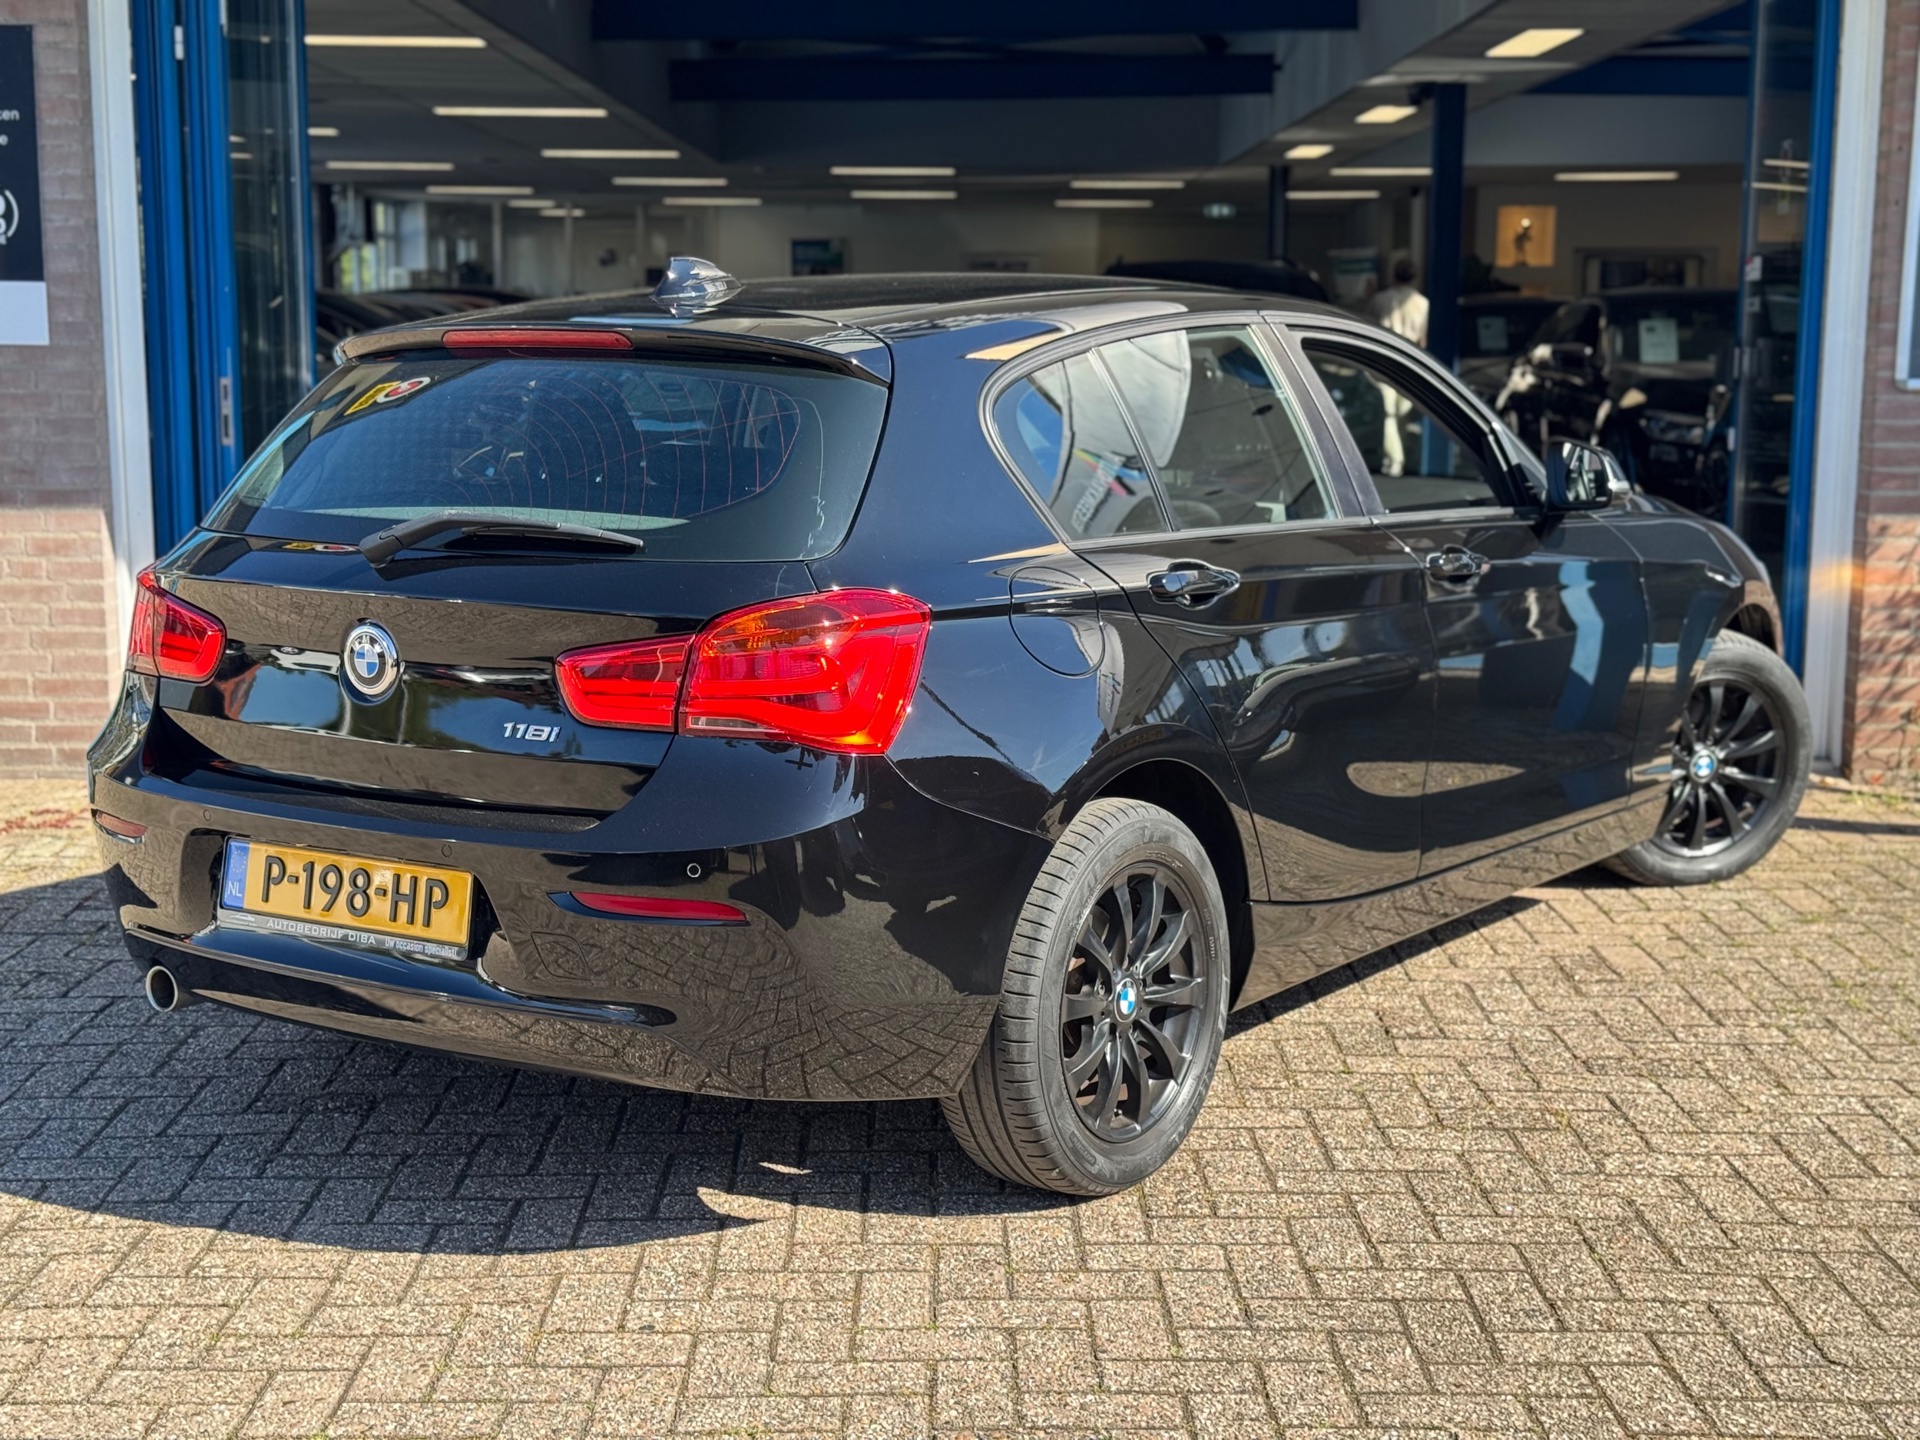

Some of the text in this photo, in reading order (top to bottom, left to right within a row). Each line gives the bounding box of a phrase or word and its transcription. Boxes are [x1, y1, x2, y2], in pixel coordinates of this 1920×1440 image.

[503, 721, 561, 742] 118i
[227, 880, 243, 897] NL
[261, 855, 449, 928] P-198-HP
[266, 918, 376, 945] AUTOBEDRIJF DIBA
[395, 941, 424, 953] occasion
